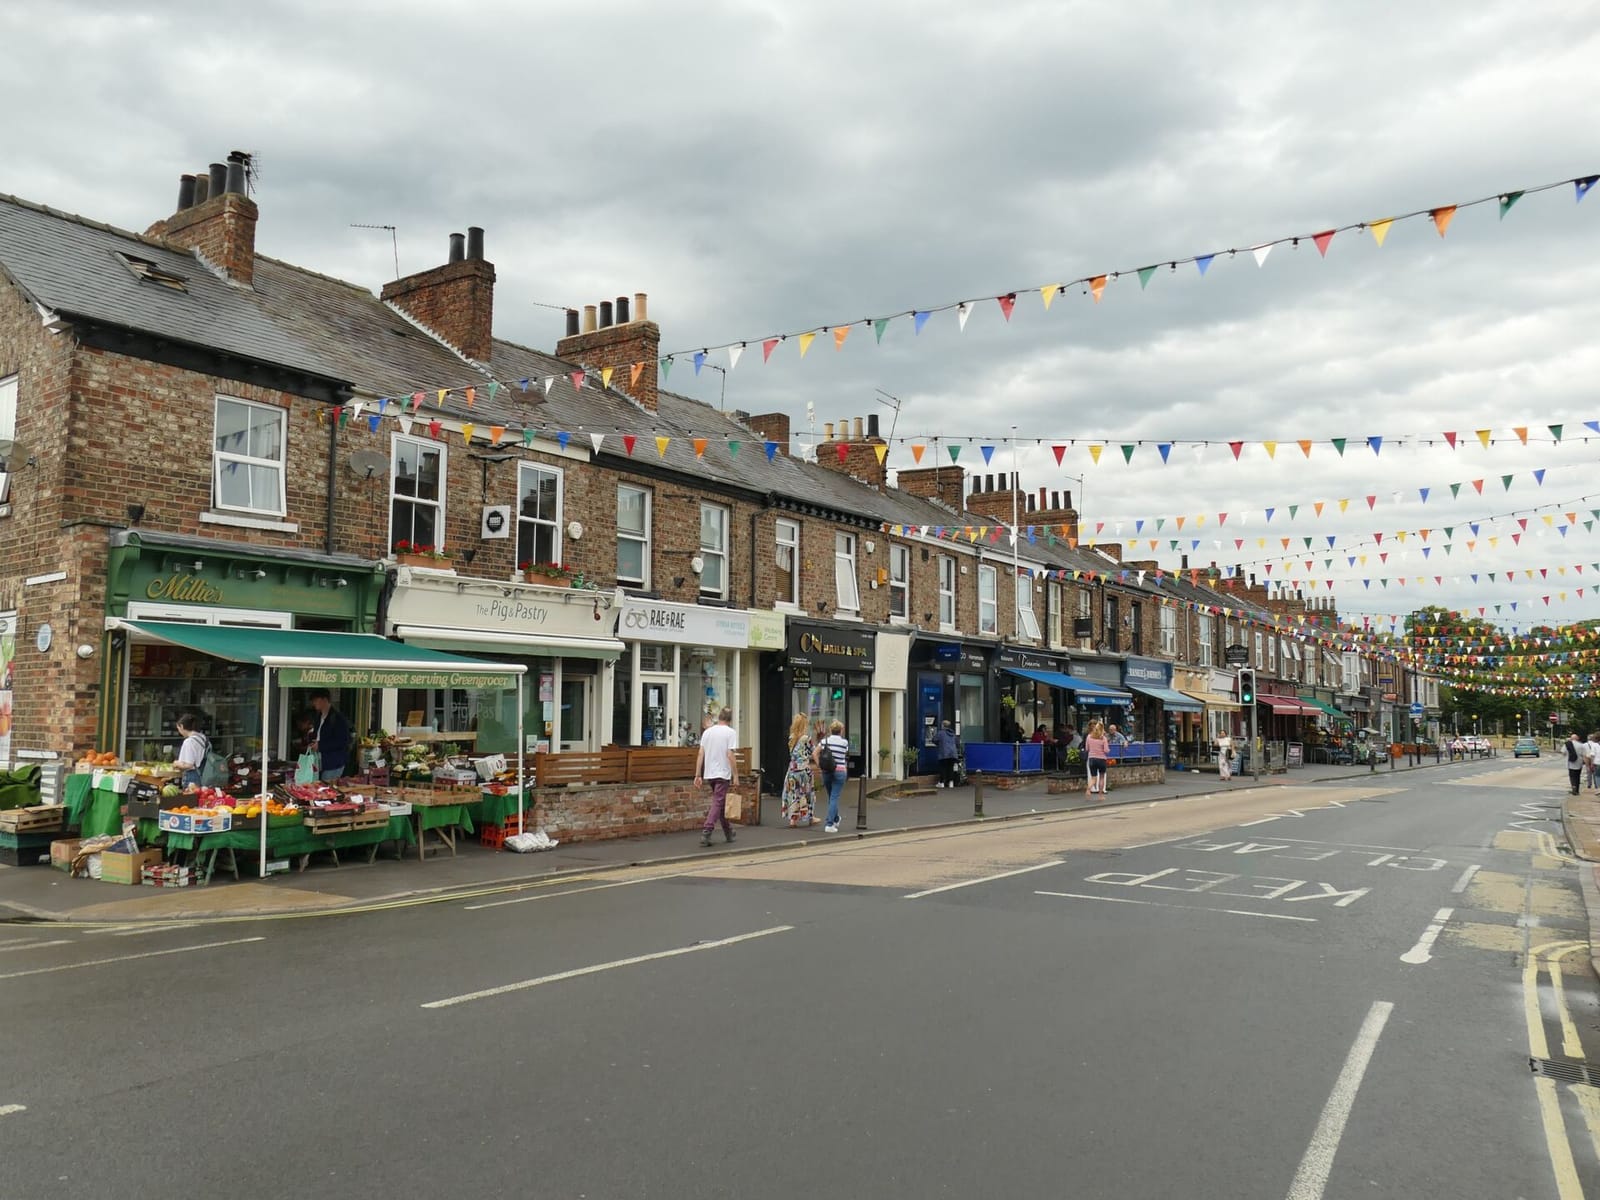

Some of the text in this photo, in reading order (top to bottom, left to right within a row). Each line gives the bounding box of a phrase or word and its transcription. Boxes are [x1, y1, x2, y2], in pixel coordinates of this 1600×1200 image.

[146, 573, 224, 602] Millie's
[476, 604, 489, 616] The
[490, 600, 508, 621] Pig
[514, 602, 549, 625] Pastry
[300, 669, 337, 683] Millies
[371, 671, 408, 686] longest
[410, 673, 449, 688] serving
[450, 672, 509, 689] Greengrocer
[1084, 868, 1372, 907] KEEP
